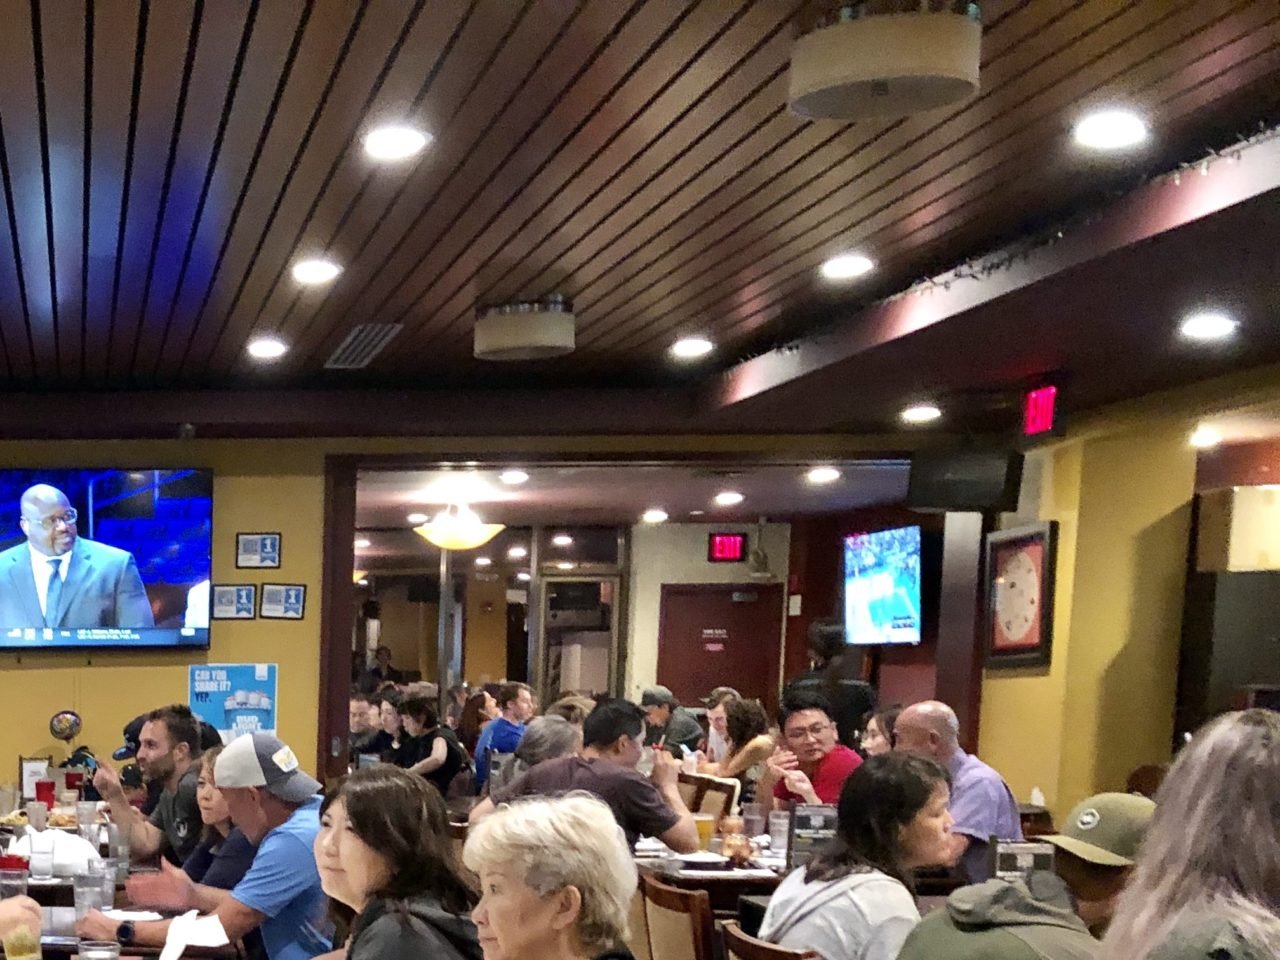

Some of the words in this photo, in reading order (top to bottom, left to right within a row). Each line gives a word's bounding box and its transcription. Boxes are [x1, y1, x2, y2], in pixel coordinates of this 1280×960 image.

[1026, 387, 1056, 433] EXIT
[263, 538, 273, 552] 1
[715, 536, 742, 558] EXIT
[239, 589, 248, 604] 1
[288, 589, 297, 604] 1
